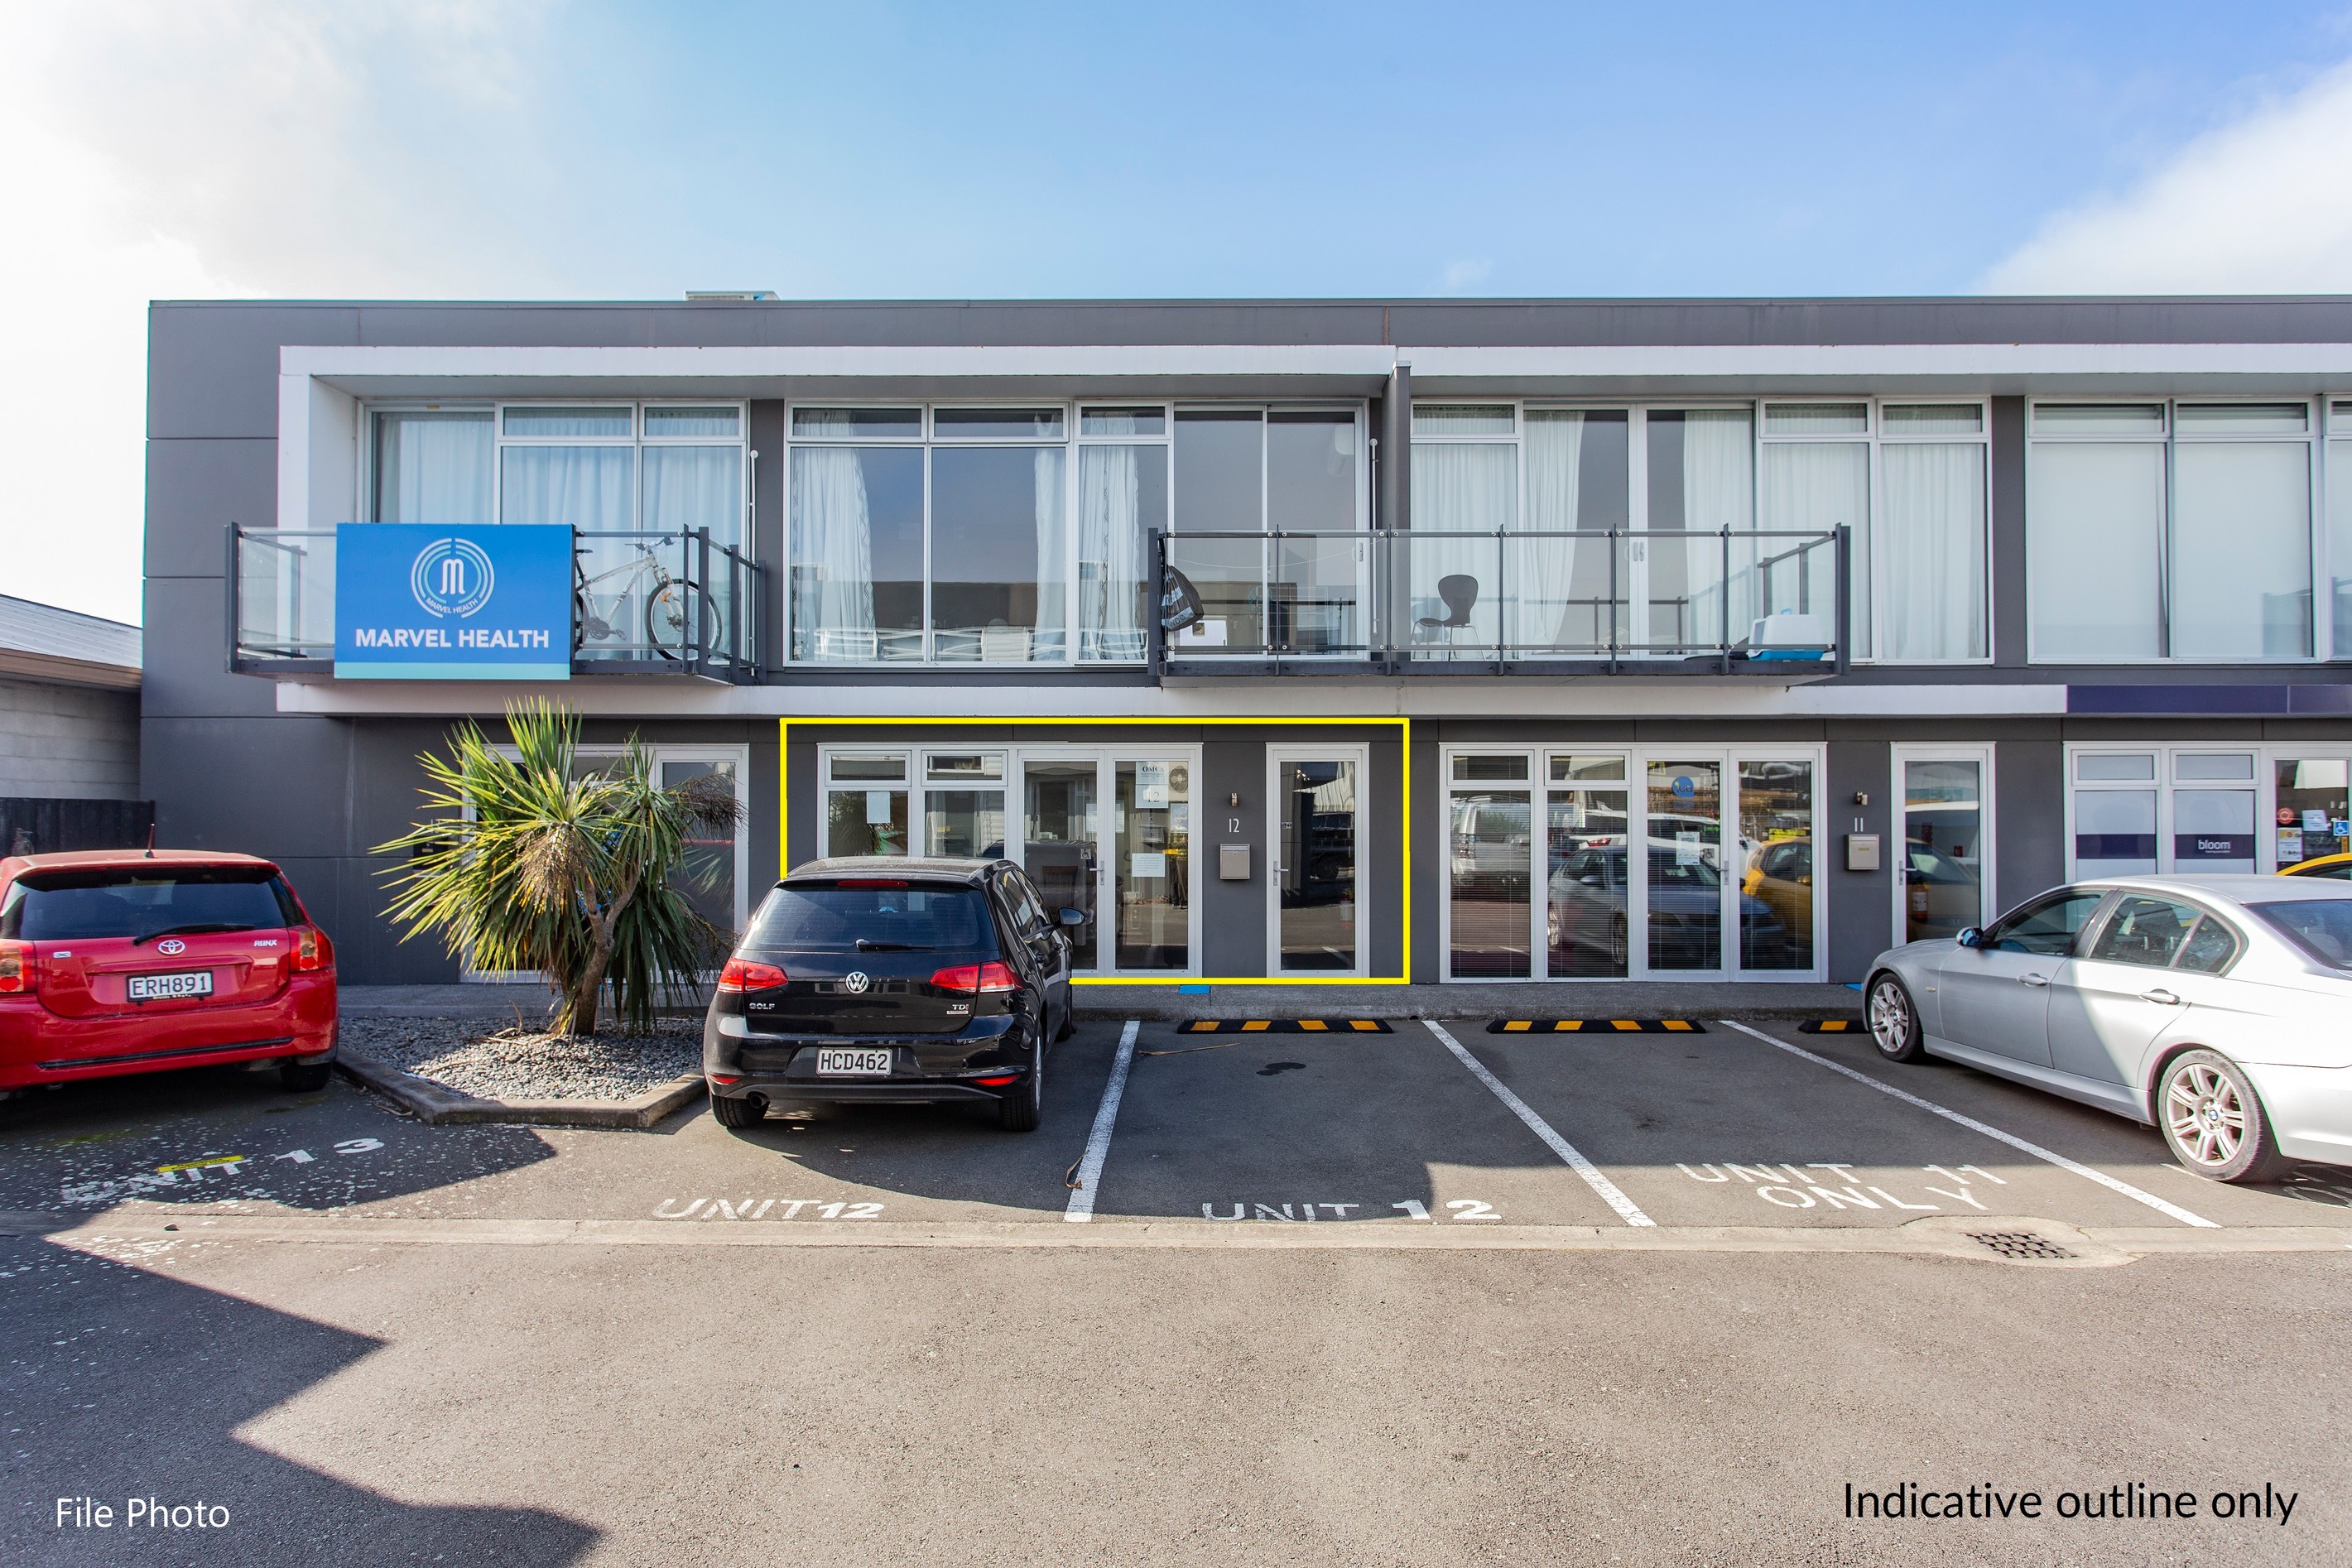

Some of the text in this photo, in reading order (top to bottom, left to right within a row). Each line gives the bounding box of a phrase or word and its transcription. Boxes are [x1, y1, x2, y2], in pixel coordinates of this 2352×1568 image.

[426, 598, 479, 613] MARVEL HEALTH
[355, 629, 550, 648] MARVEL HEALTH
[1229, 818, 1240, 833] 12
[1854, 817, 1864, 832] 11
[2198, 839, 2231, 849] bloom
[132, 975, 206, 995] ERH891
[820, 1052, 888, 1070] HCD462
[1675, 1163, 2008, 1186] UNIT 11
[1756, 1186, 1989, 1211] ONLY
[1201, 1202, 1359, 1221] UNIT
